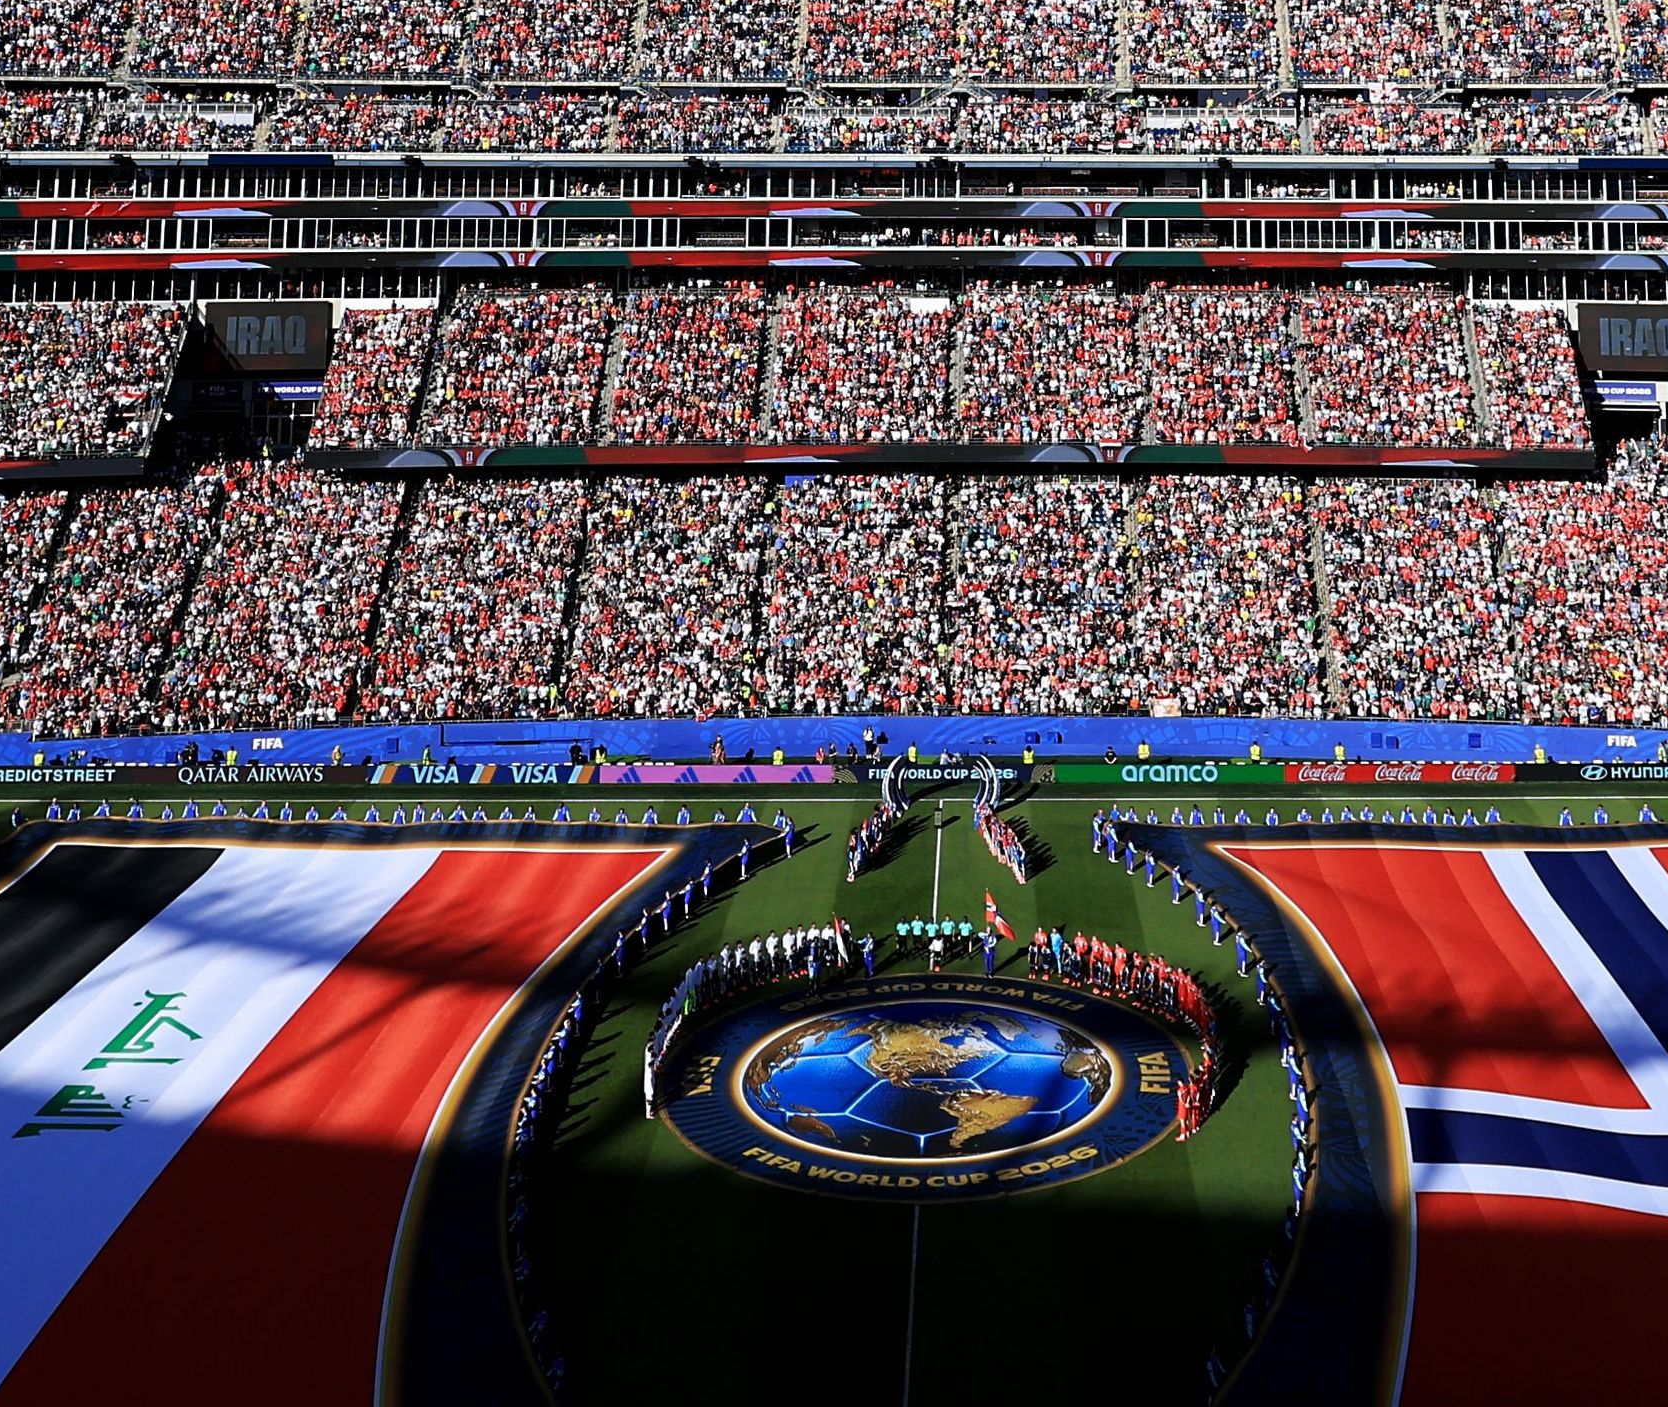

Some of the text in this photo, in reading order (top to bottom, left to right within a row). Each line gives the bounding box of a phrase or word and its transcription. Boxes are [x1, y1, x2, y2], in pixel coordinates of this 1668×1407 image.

[226, 314, 307, 355] IRAQ
[274, 386, 301, 394] WORLD
[302, 386, 318, 394] CUP
[1610, 387, 1625, 395] CUP
[252, 736, 284, 751] FIFA
[1606, 734, 1637, 748] FIFA
[177, 766, 324, 785] QATAR AIRWAYS
[411, 765, 459, 784] VISA
[509, 765, 558, 784] VISA
[943, 768, 969, 780] CUP
[1121, 763, 1219, 784] aramco
[931, 982, 1026, 998] WORLD
[1031, 990, 1086, 1013] FIFA
[1135, 1051, 1173, 1094] FIFA
[741, 1145, 1100, 1188] FIFA WORLD CUP 2026
